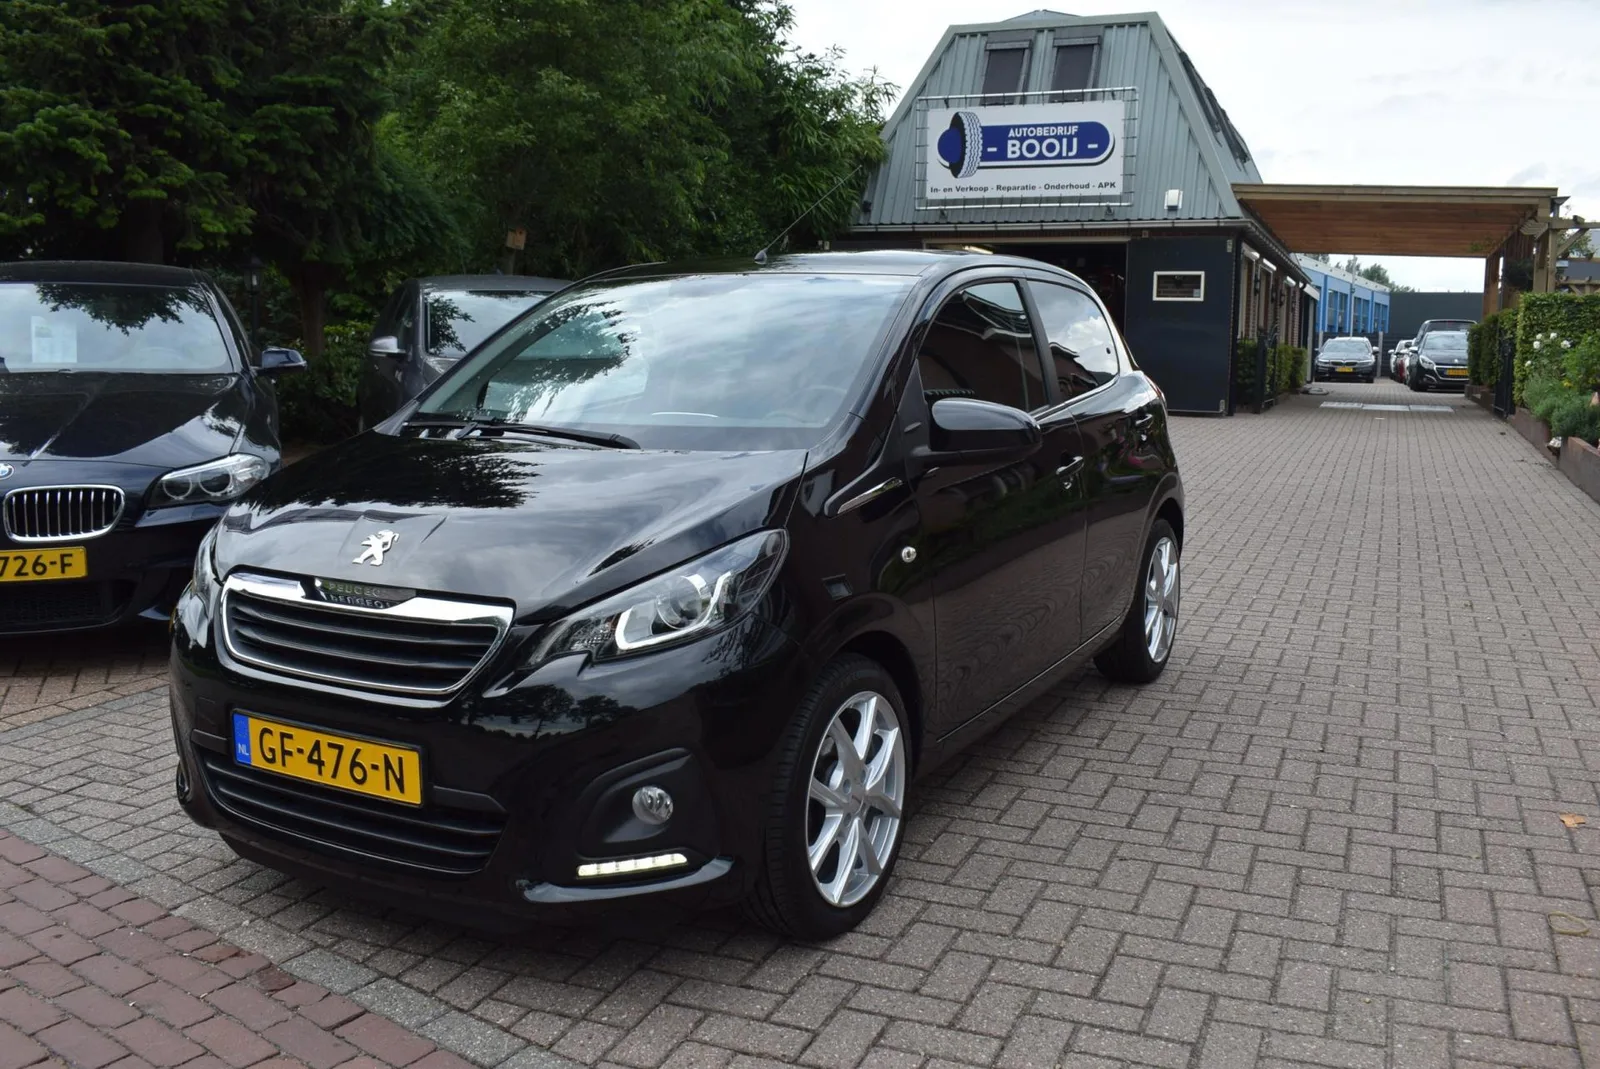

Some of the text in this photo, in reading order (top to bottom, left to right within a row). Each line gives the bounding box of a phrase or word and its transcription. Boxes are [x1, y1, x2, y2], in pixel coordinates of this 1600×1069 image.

[1008, 126, 1078, 137] AUTOBEDRIJF
[1007, 138, 1078, 158] BOOIJ
[996, 184, 1036, 192] Reparatie
[238, 744, 249, 756] NL
[259, 727, 405, 794] GF-476-N
